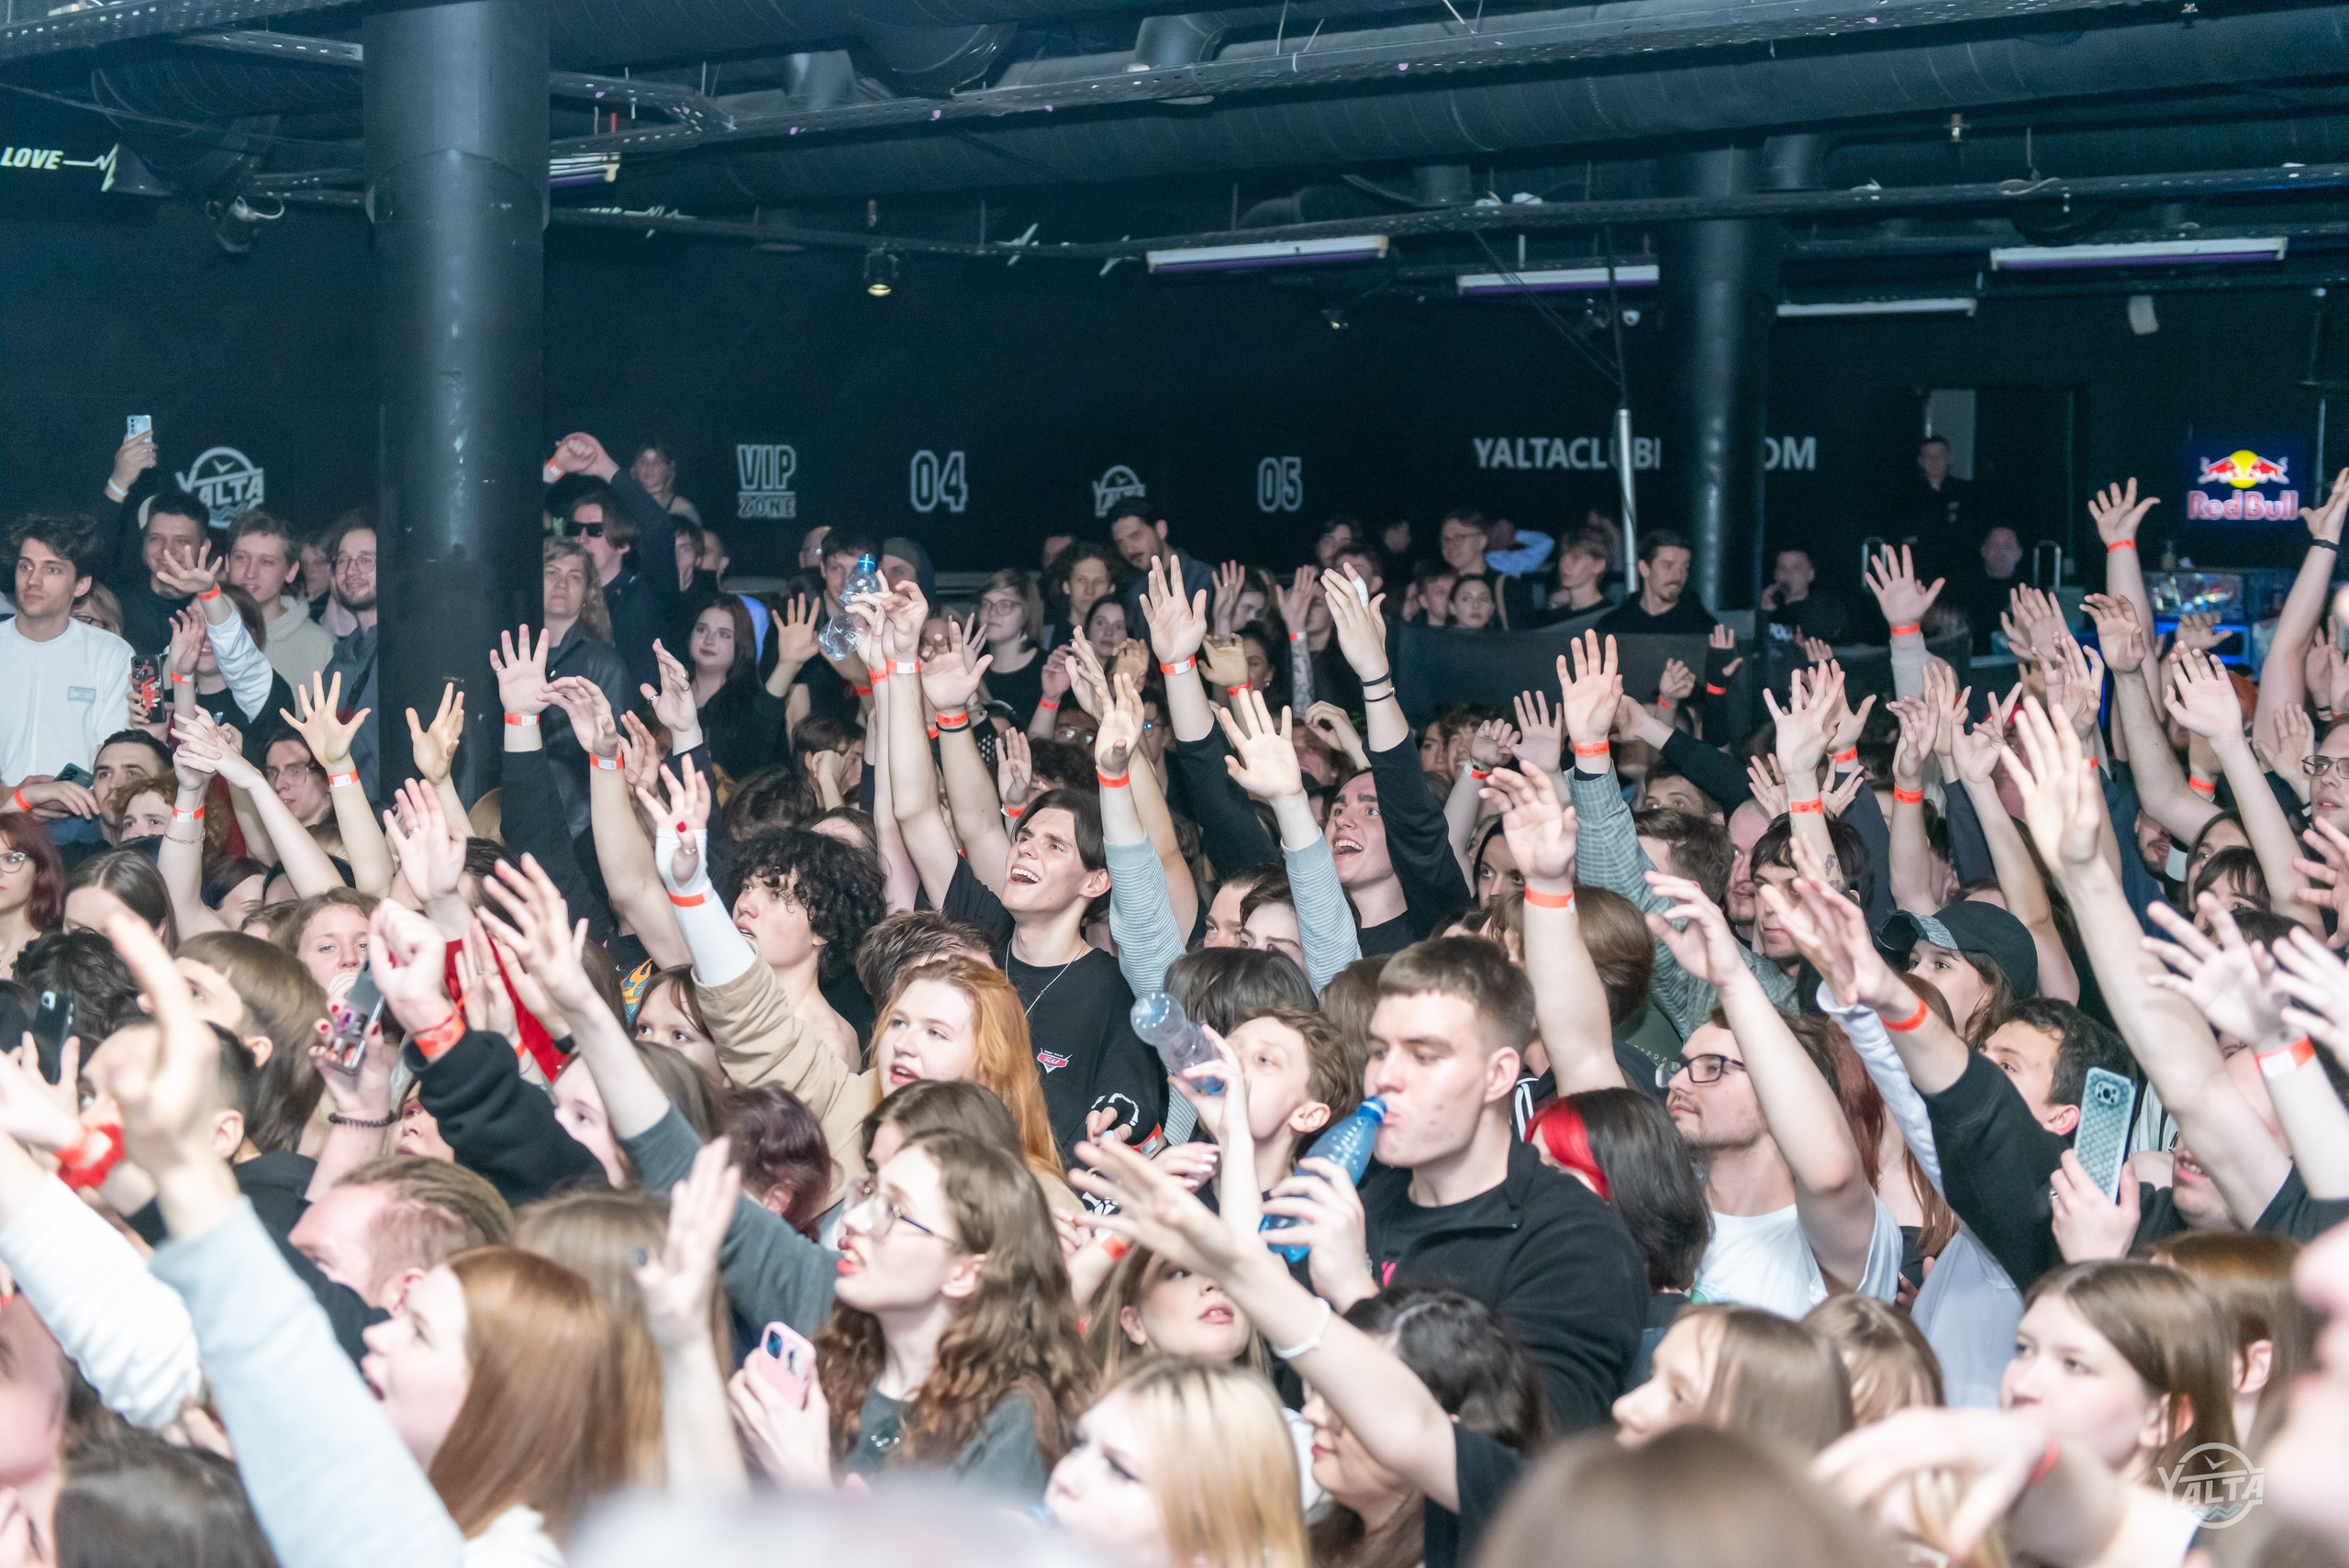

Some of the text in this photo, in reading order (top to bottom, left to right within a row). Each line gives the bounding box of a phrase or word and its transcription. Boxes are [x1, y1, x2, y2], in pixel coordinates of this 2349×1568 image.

[0, 147, 64, 171] LOVE
[737, 444, 796, 490] VIP
[910, 450, 969, 513] 04
[1258, 456, 1303, 512] 05
[737, 495, 796, 520] ZONE
